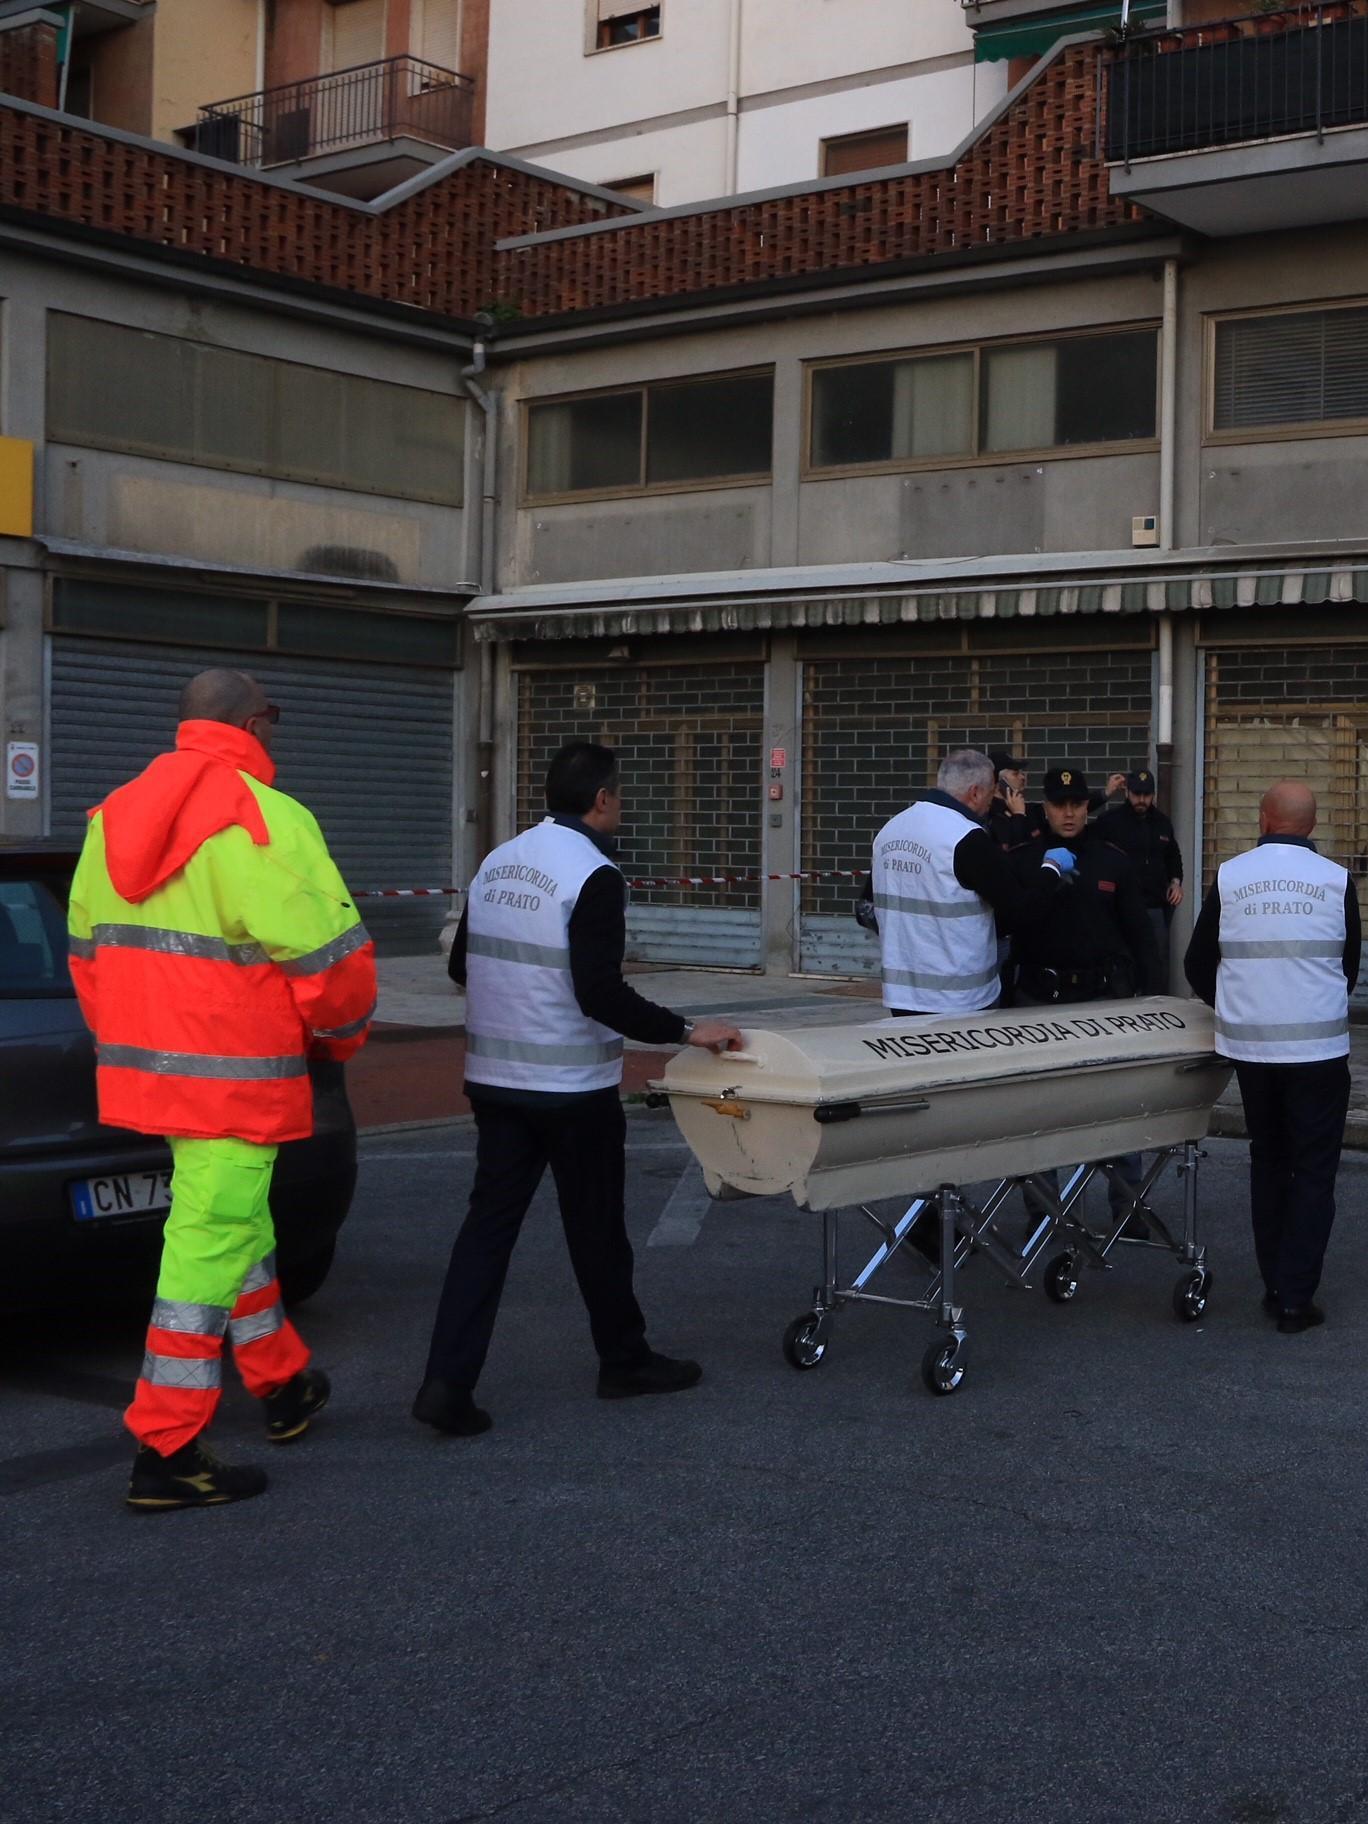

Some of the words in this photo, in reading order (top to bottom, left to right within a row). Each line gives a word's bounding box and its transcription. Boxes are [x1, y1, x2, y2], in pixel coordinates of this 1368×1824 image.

[881, 839, 932, 863] MISERICORDIA
[892, 859, 922, 874] PRATO
[483, 864, 558, 897] MISERICORDIA
[1233, 879, 1326, 902] MISERICORDIA
[484, 889, 497, 903] di
[497, 890, 541, 911] PRATO
[1244, 903, 1257, 916] di
[1262, 901, 1314, 916] PRATO
[862, 1023, 1080, 1060] MISERICORDIA
[1070, 1018, 1114, 1037] DI
[1104, 1011, 1186, 1034] PRATO
[94, 1177, 133, 1211] CN
